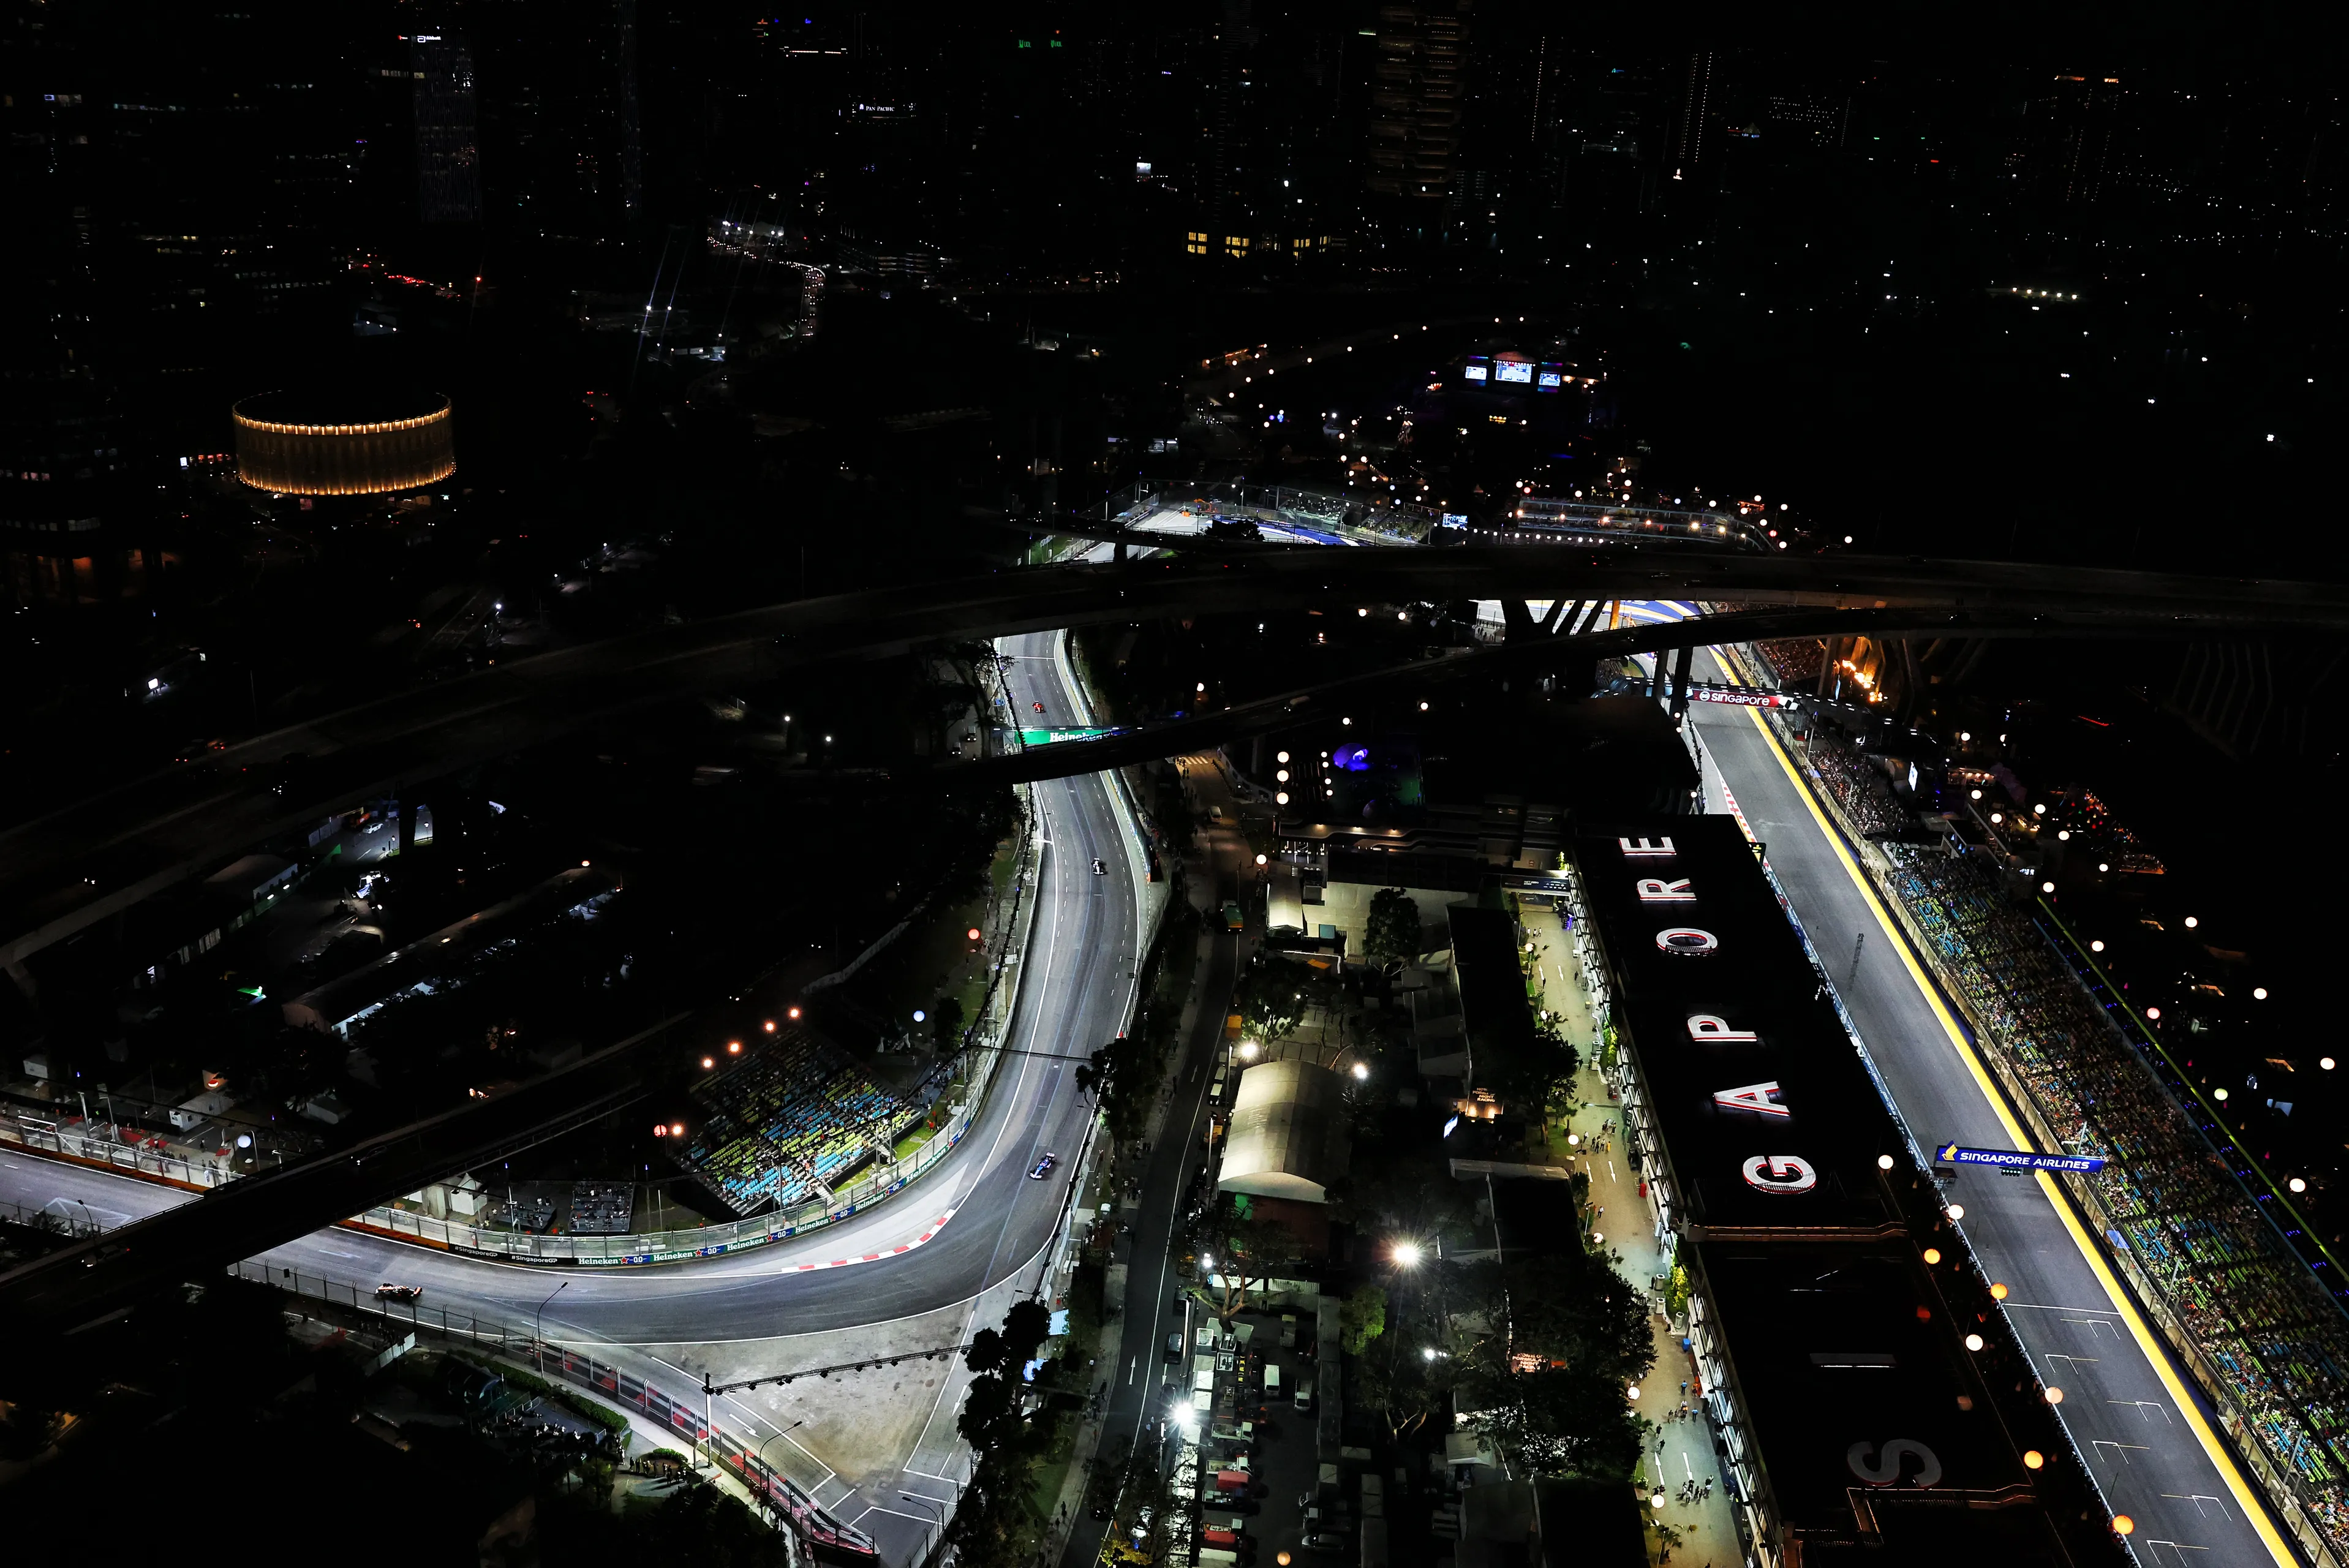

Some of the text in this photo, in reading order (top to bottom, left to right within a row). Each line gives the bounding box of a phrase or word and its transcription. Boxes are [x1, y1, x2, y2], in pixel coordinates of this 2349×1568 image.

[906, 1147, 946, 1183] Heineken
[1960, 1152, 2090, 1170] SINGAPORE AIRLINES
[855, 1194, 884, 1212] Heineken
[795, 1218, 829, 1234] Heineken
[454, 1246, 498, 1257] #SingaporeGP
[726, 1237, 765, 1251] Heineken
[511, 1254, 558, 1264] #SingaporeGP
[654, 1251, 693, 1261] Heineken
